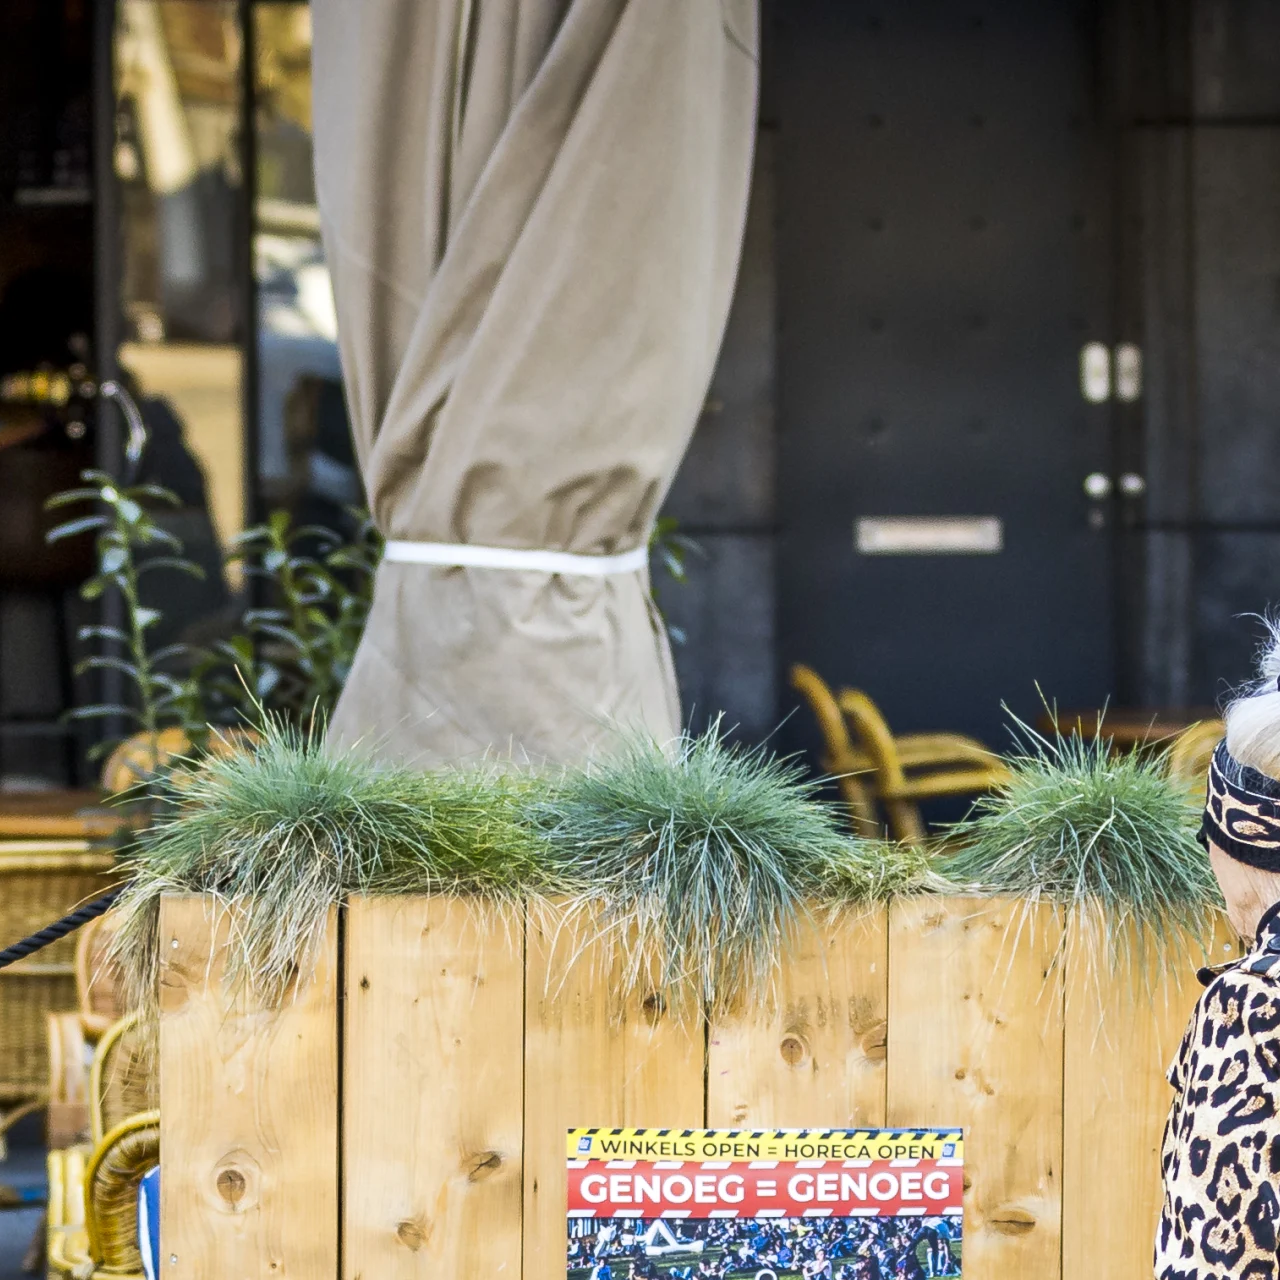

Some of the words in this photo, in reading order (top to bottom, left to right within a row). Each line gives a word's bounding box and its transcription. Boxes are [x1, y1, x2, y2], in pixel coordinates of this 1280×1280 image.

[600, 1139, 696, 1156] WINKELS
[702, 1142, 760, 1157] OPEN
[785, 1144, 871, 1158] HORECA
[878, 1145, 935, 1160] OPEN
[580, 1174, 745, 1204] GENOEG
[787, 1171, 950, 1202] GENOEG
